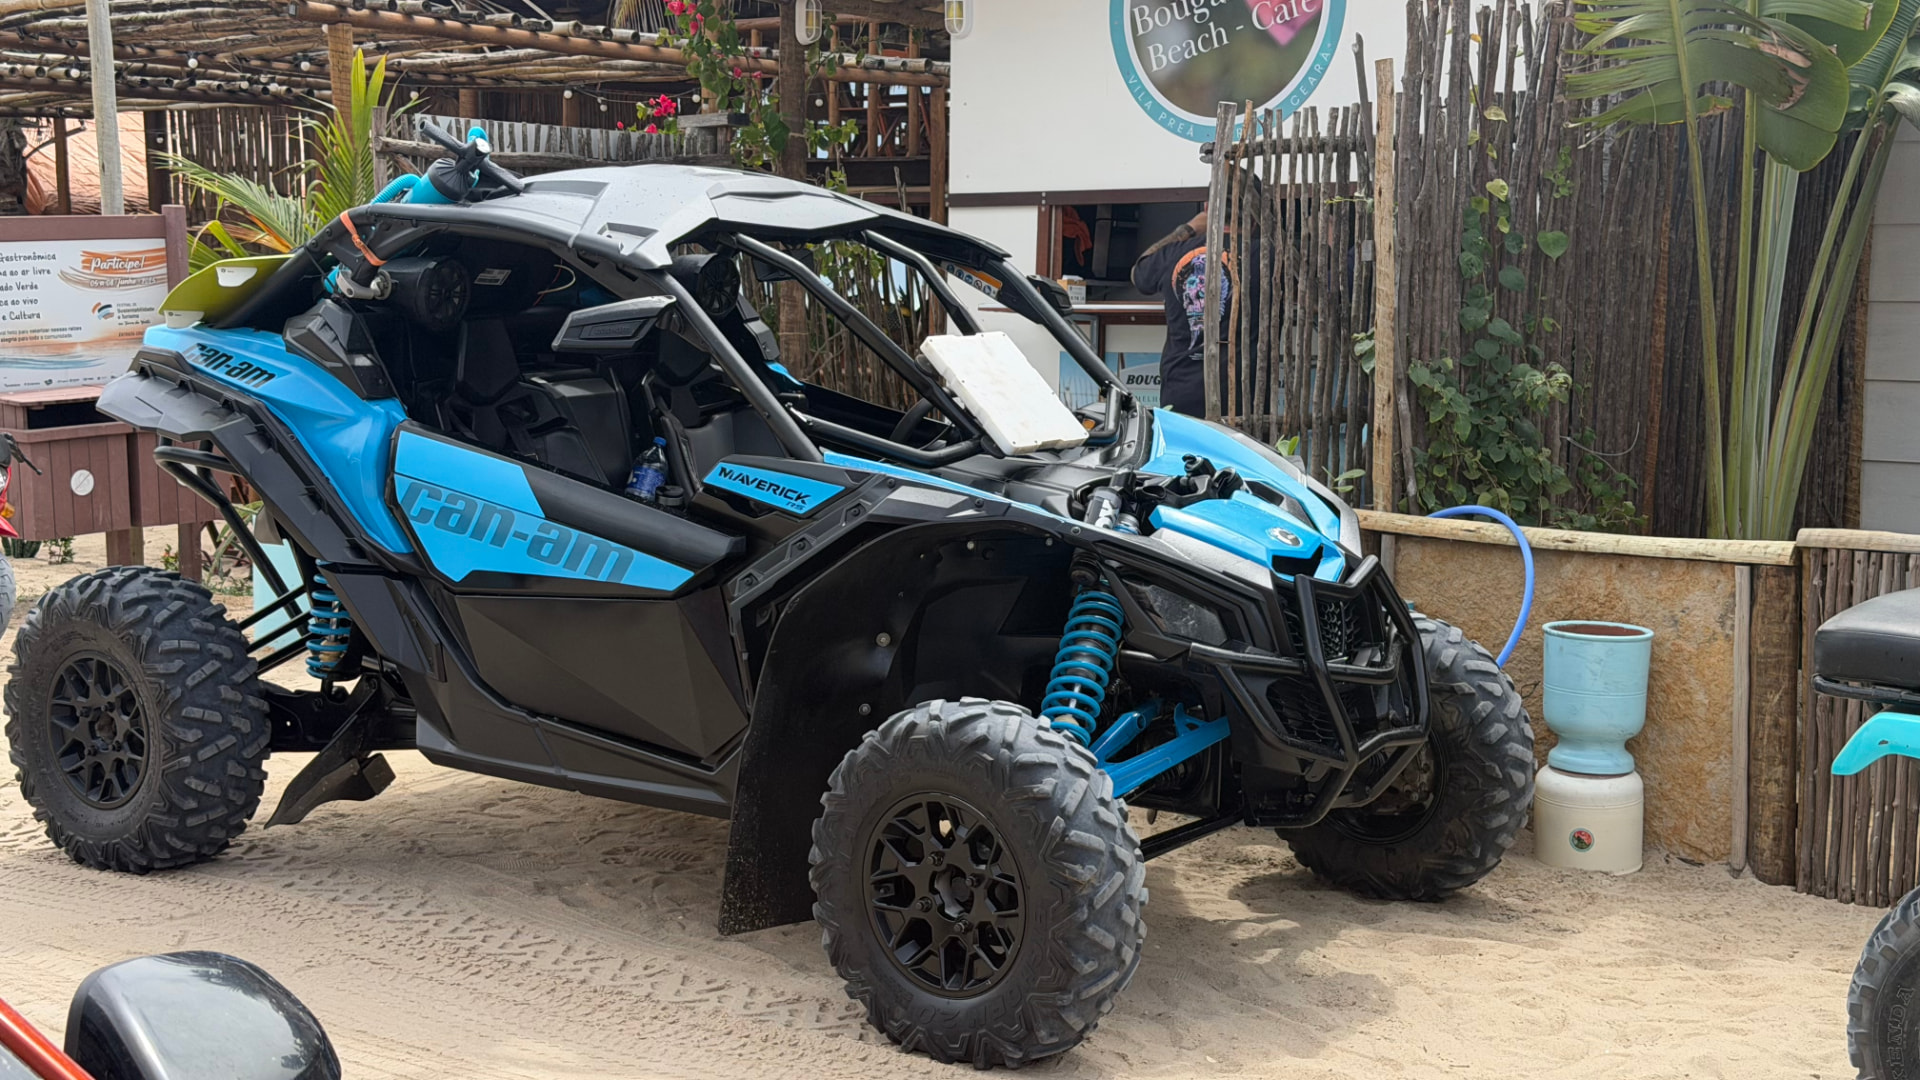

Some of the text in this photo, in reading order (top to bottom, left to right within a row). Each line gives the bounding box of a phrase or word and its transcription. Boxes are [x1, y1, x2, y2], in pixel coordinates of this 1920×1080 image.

[1147, 21, 1229, 72] Beach
[1128, 75, 1153, 111] VILA
[33, 266, 51, 275] livre
[90, 255, 146, 273] Participe!
[16, 281, 38, 290] Verde
[22, 297, 38, 305] vivo
[9, 310, 41, 320] Cultura
[181, 342, 276, 389] can-am
[718, 466, 811, 505] MAVERICK
[403, 480, 635, 583] can-am
